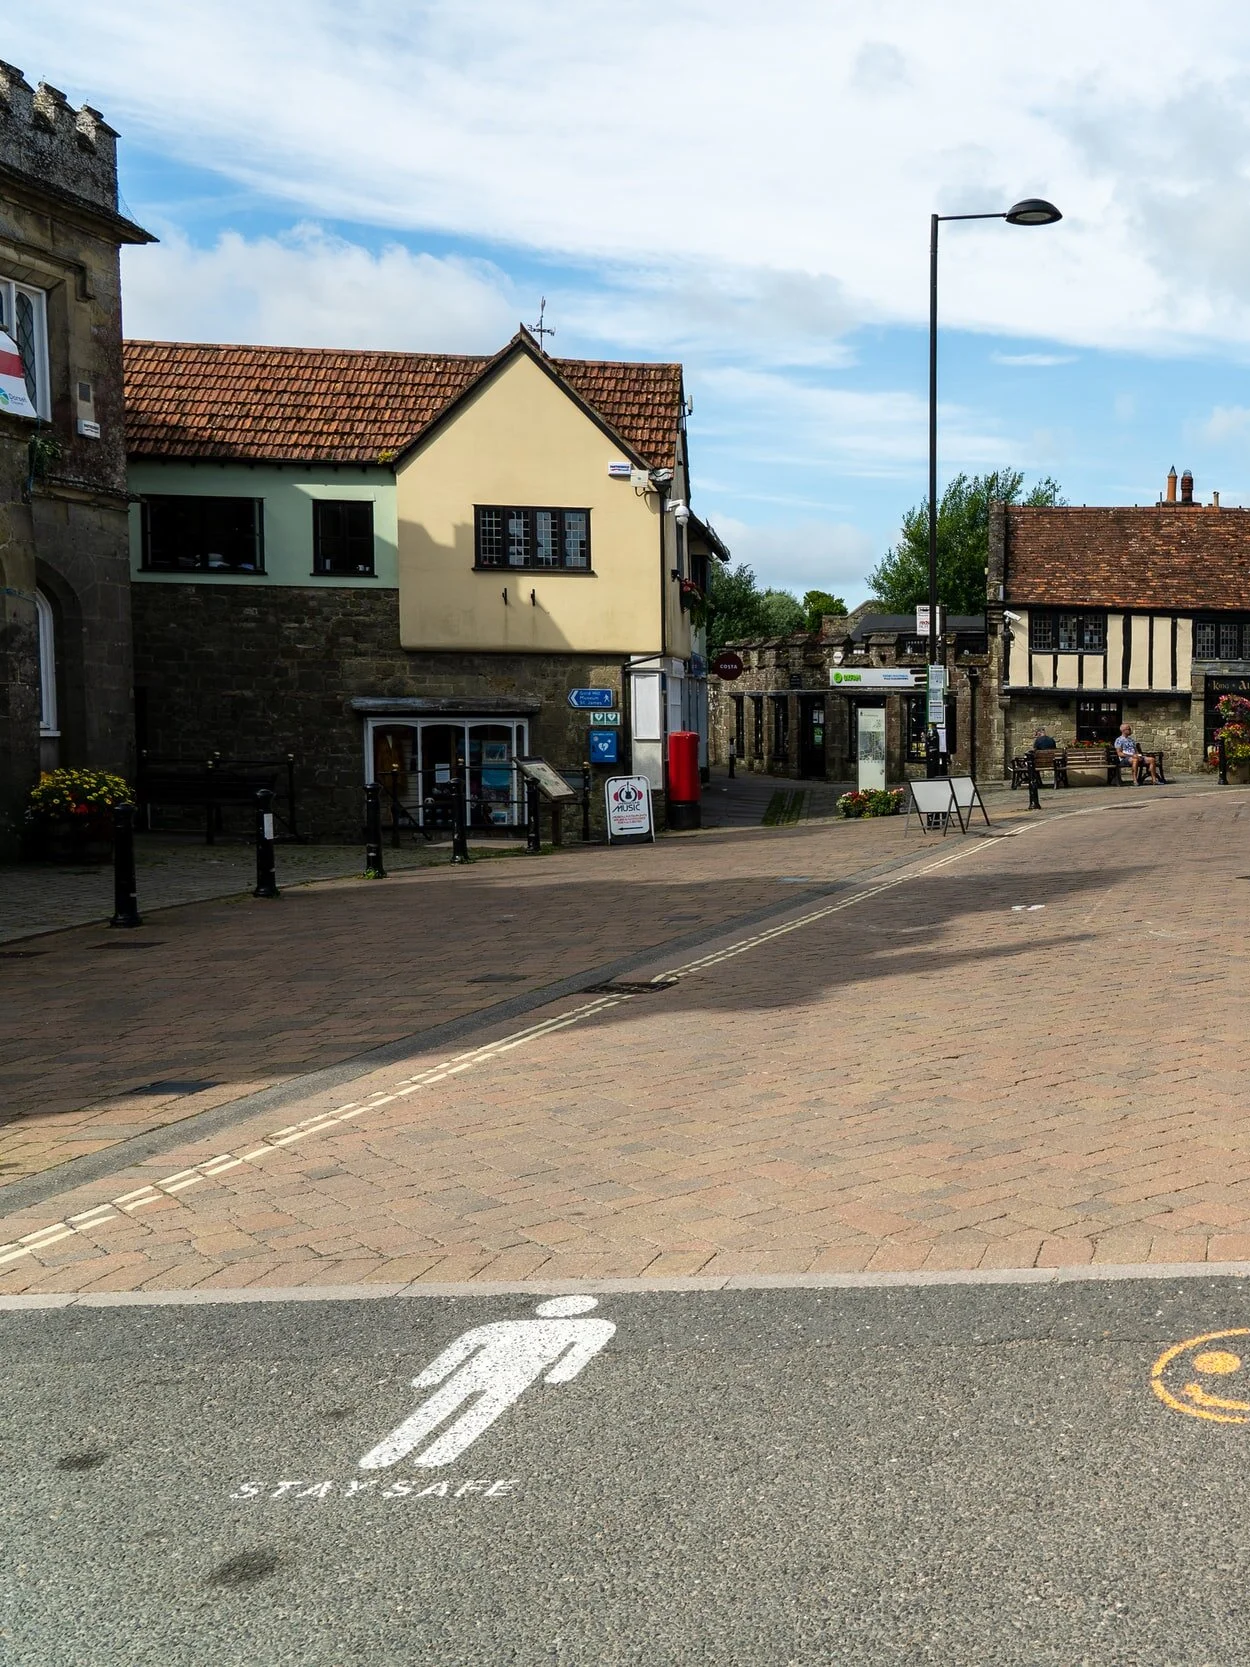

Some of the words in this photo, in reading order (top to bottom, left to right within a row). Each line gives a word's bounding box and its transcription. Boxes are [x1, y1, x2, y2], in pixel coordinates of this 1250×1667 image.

[612, 804, 640, 812] MUSIC
[229, 1480, 381, 1500] STAY
[382, 1480, 521, 1498] SAFE
